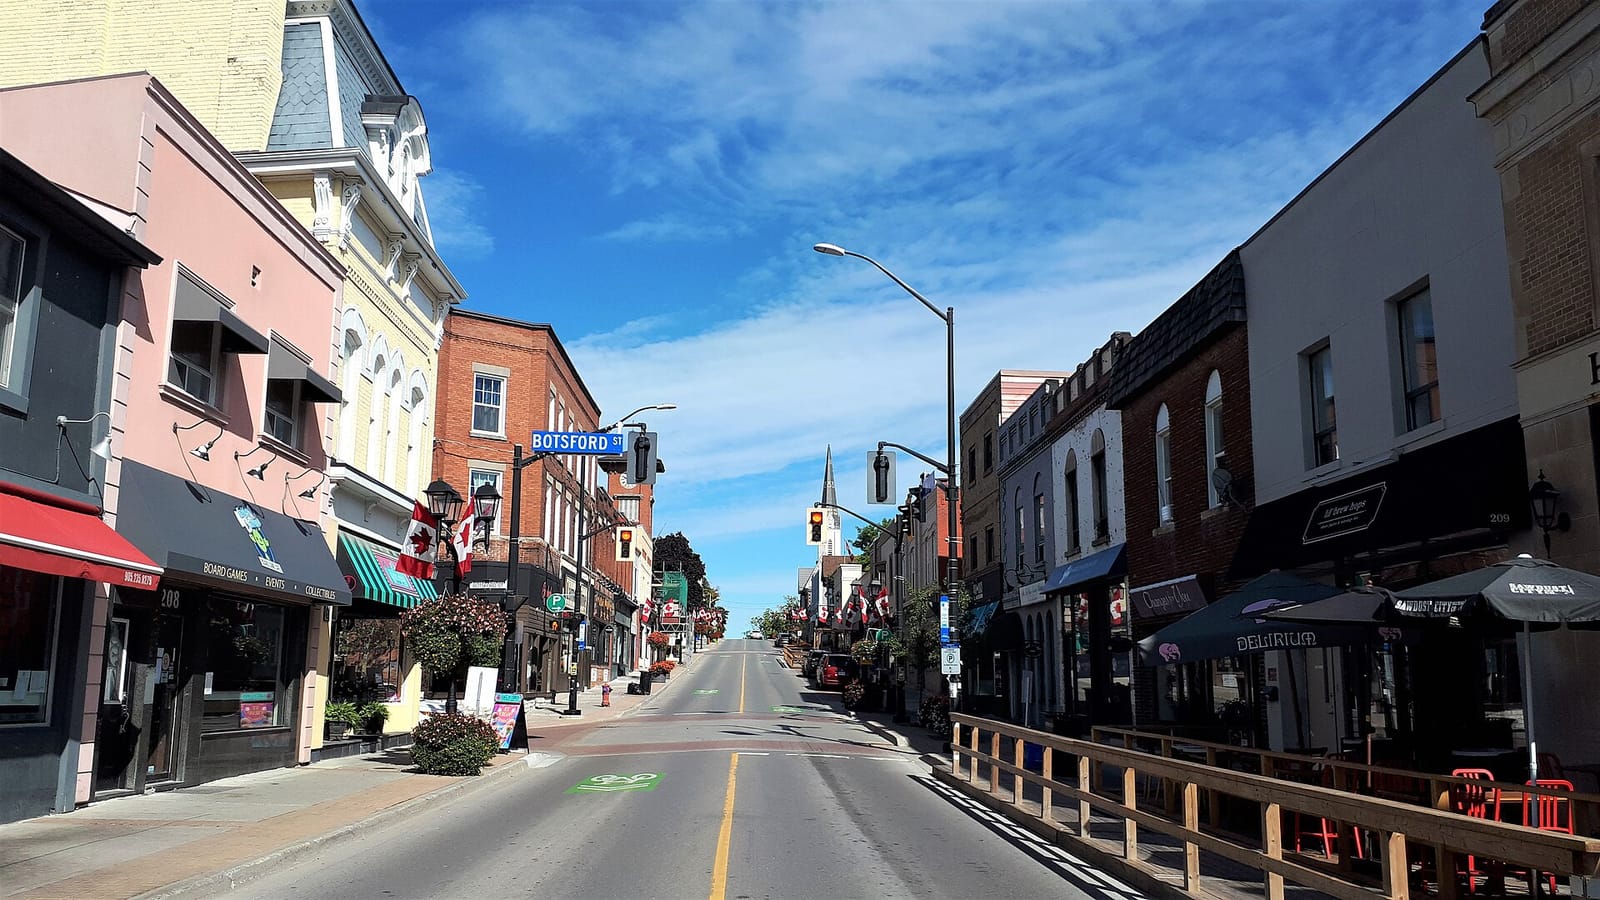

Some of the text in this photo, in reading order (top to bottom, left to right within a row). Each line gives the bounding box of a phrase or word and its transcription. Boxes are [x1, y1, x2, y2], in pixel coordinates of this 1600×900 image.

[532, 433, 622, 450] BOTSFORD ST
[1490, 513, 1510, 523] 209
[203, 562, 336, 599] BOARD GAMES EVENTS COLLECTIBLES
[161, 588, 180, 609] 208
[1394, 600, 1433, 612] SAWDUST
[1237, 632, 1317, 651] DELIRIUM
